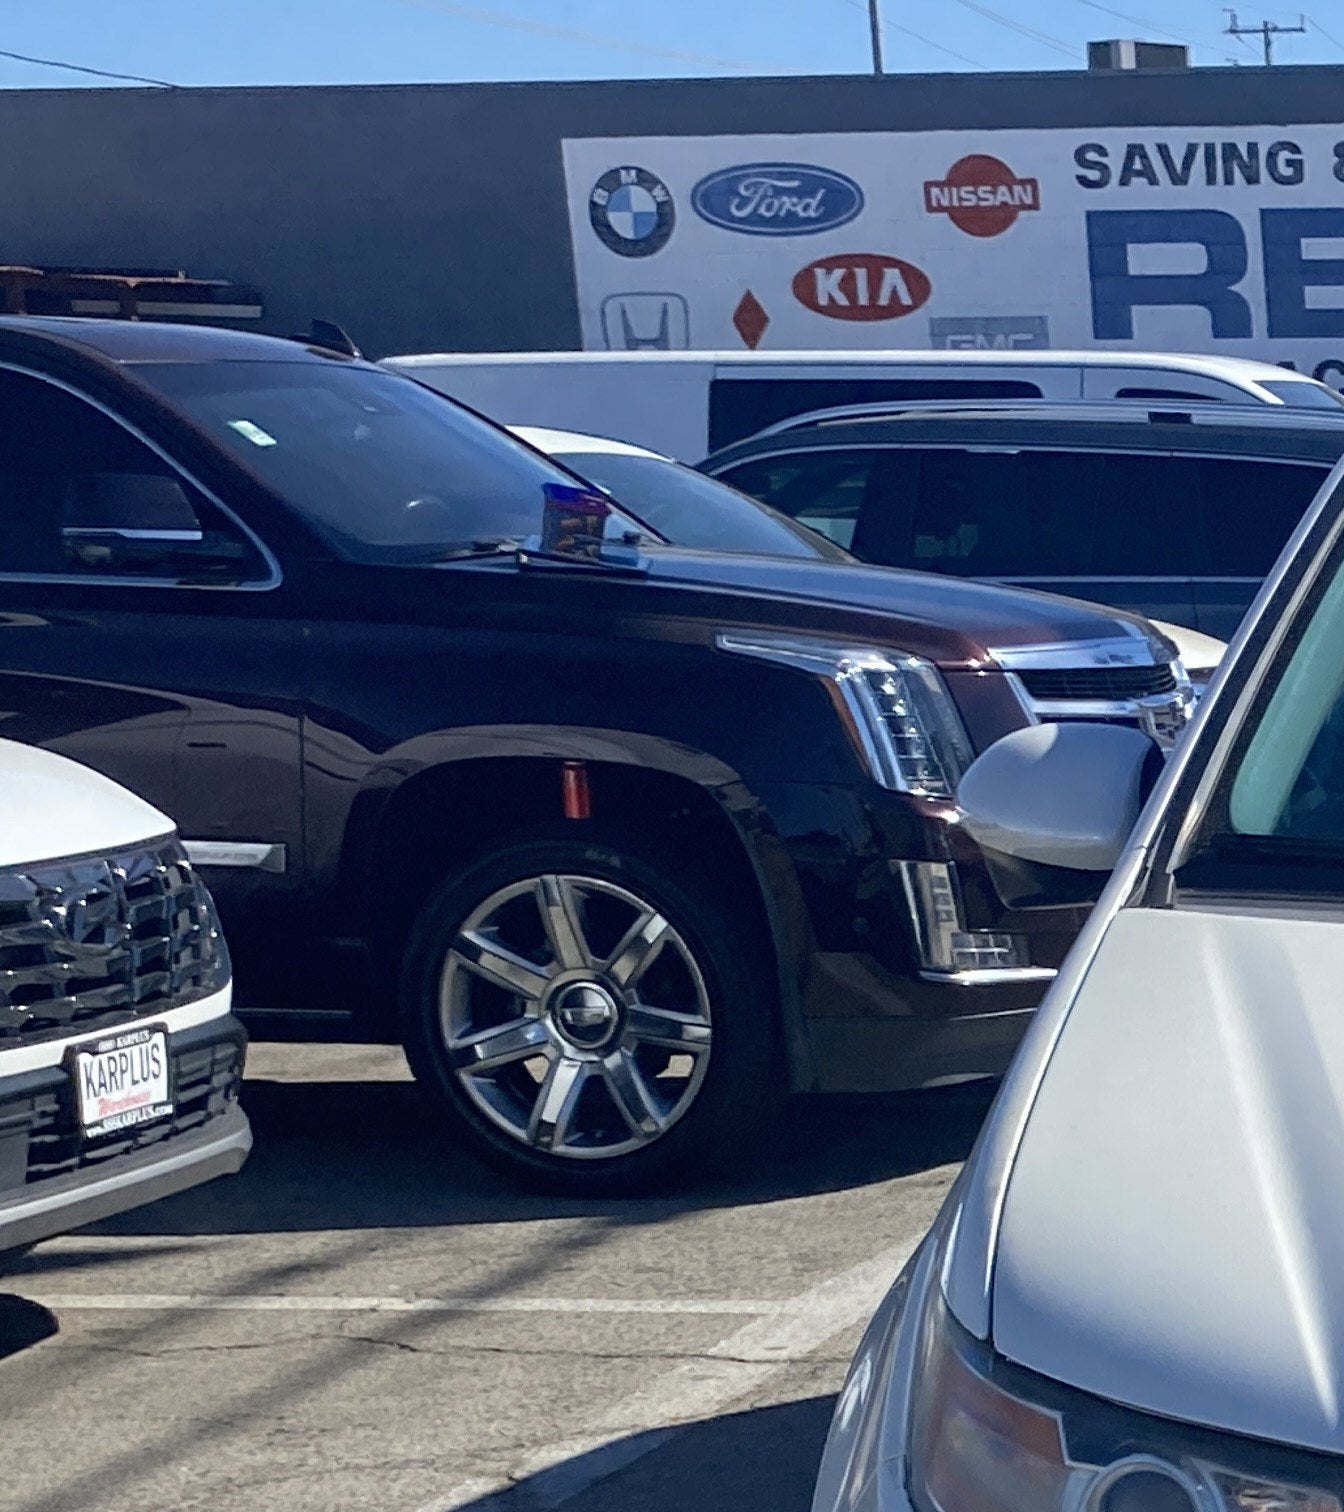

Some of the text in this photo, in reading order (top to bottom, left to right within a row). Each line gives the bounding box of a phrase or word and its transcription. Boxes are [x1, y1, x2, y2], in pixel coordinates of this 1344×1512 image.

[1073, 140, 1305, 189] SAVING
[593, 169, 669, 206] BMW
[729, 177, 826, 219] Ford
[929, 184, 1034, 208] NISSAN
[813, 266, 913, 307] KIA
[83, 1043, 162, 1100] KARPLUS
